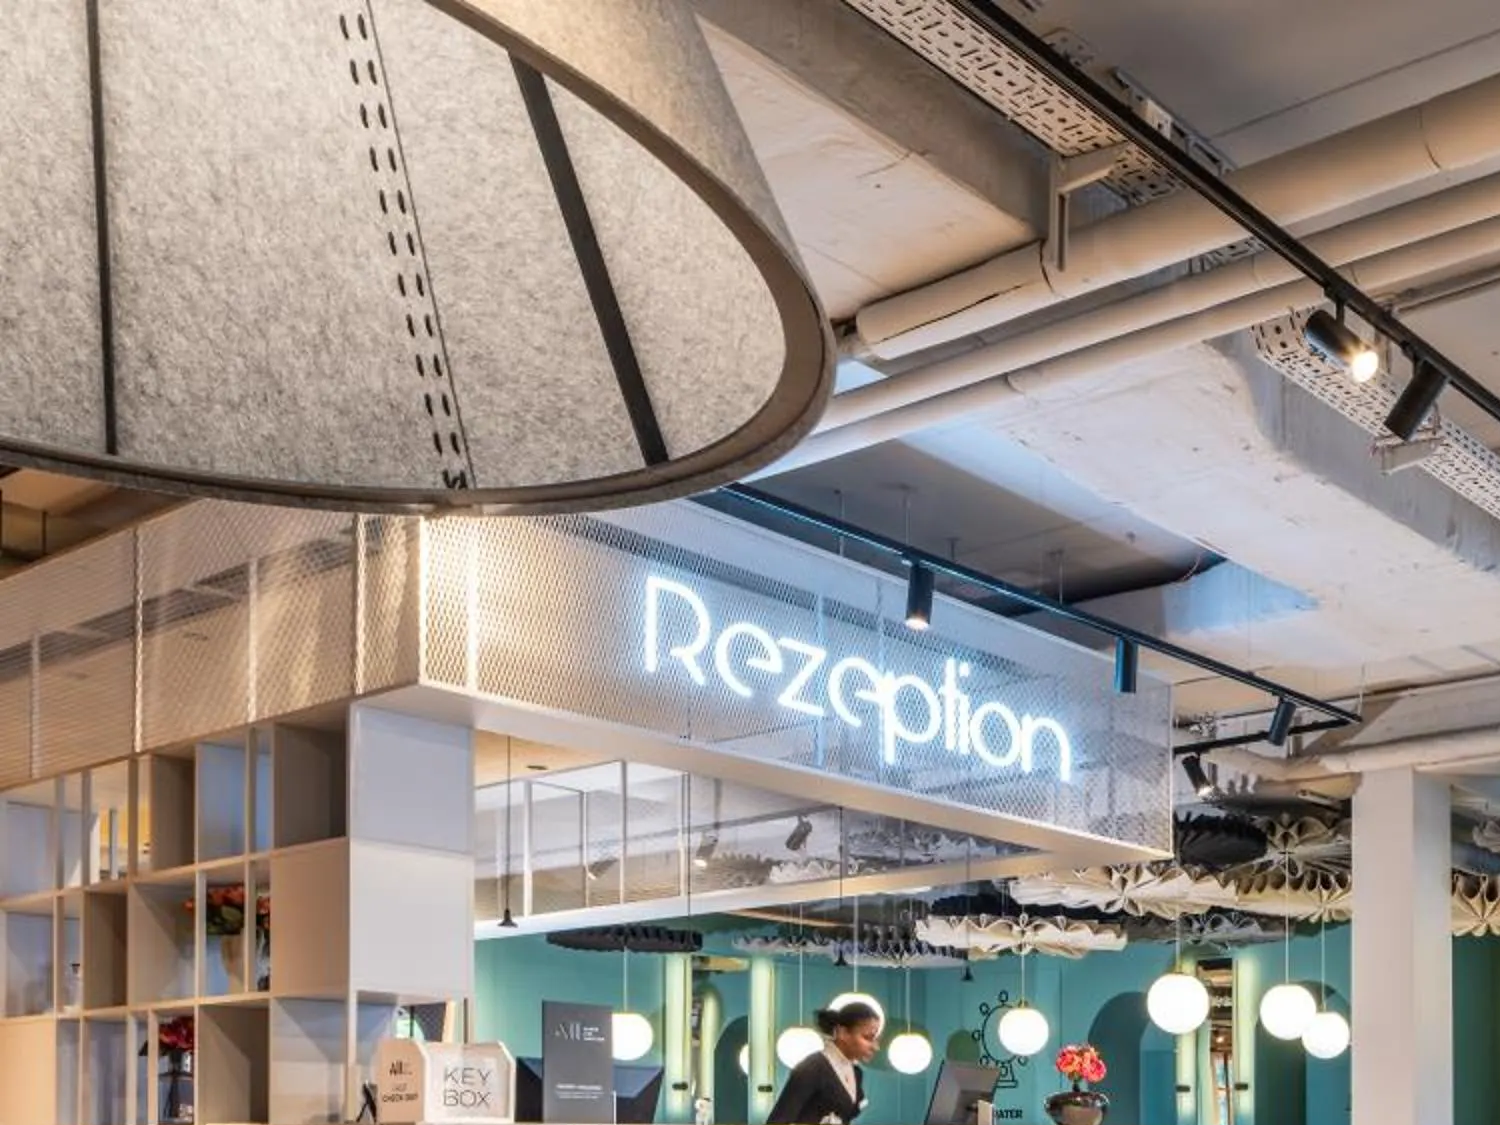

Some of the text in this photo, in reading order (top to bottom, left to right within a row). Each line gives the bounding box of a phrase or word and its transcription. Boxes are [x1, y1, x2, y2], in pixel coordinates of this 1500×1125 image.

[644, 574, 1071, 783] Rezeption
[444, 1067, 491, 1085] KEY
[443, 1089, 491, 1109] BOX
